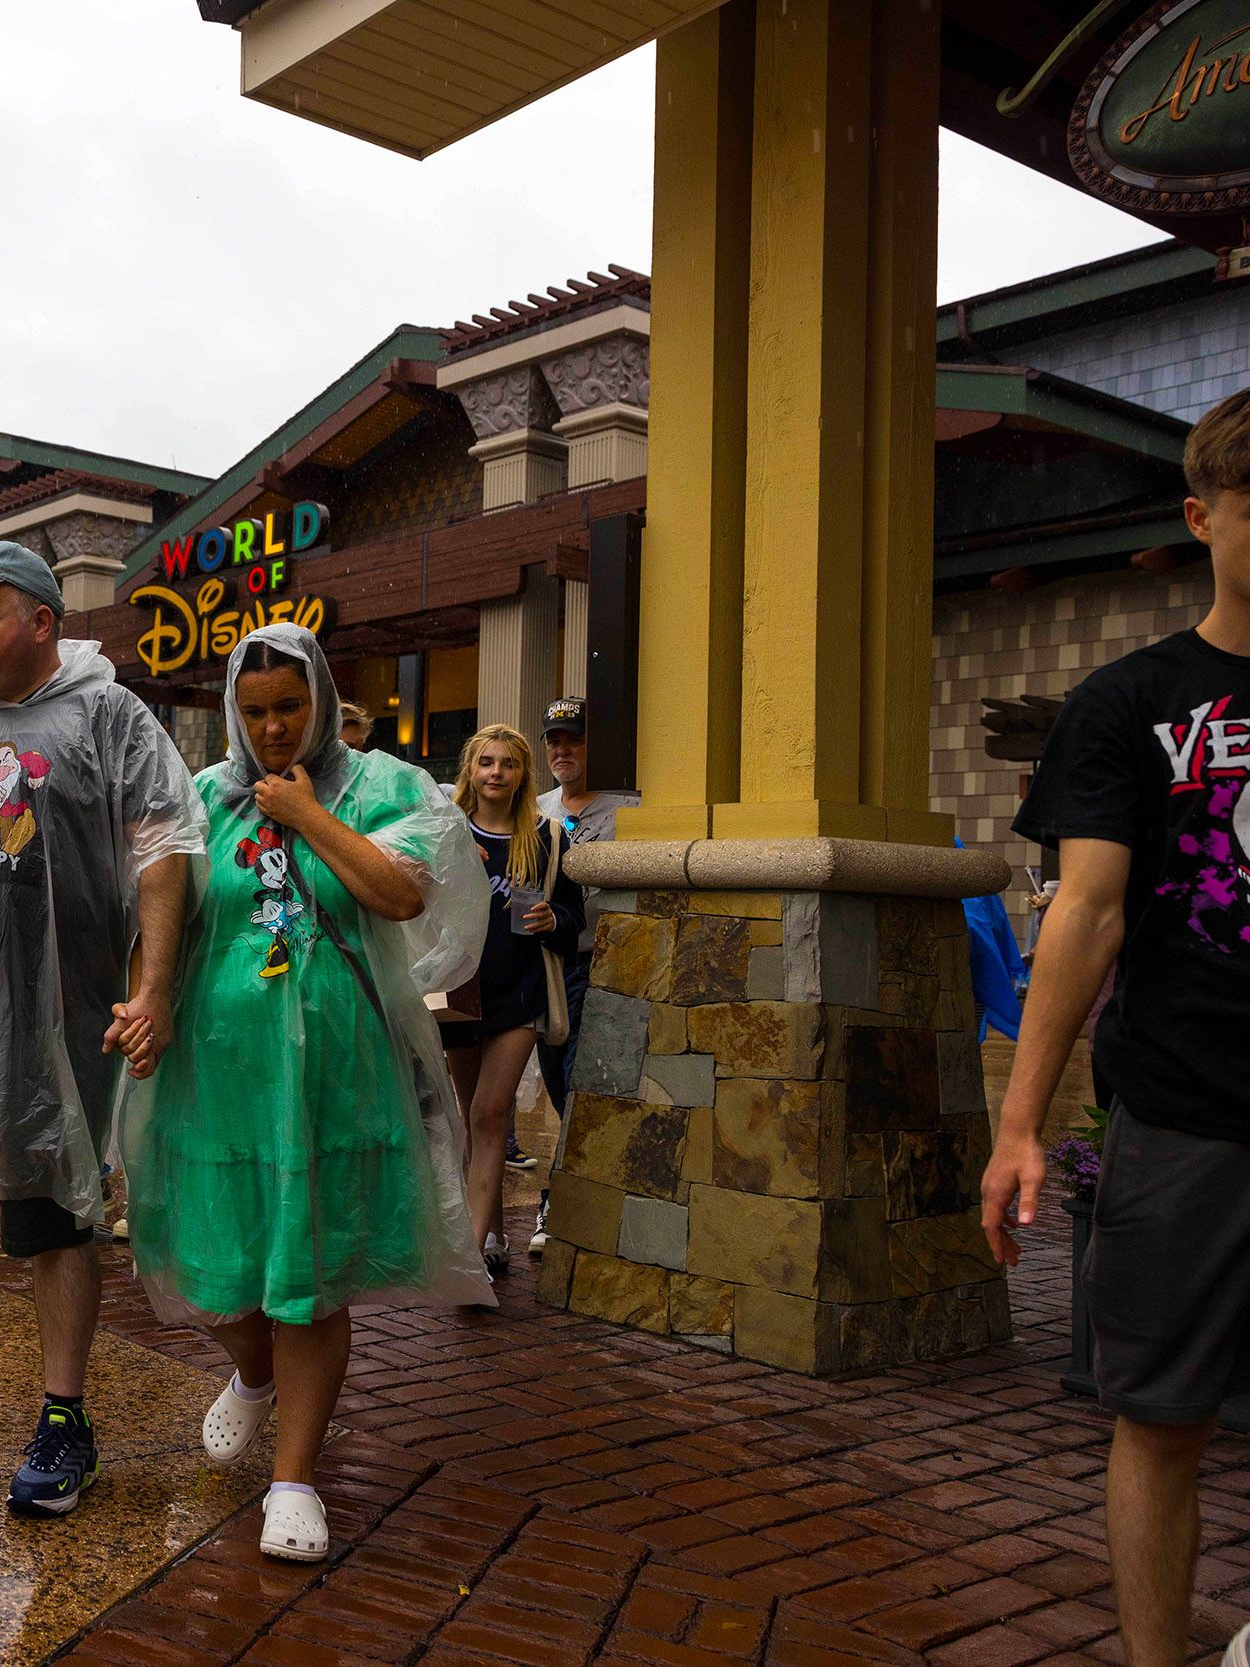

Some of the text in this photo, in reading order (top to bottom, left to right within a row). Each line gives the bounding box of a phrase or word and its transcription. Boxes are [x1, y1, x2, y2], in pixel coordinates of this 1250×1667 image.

[161, 501, 326, 579] WORLD
[248, 560, 286, 594] OF
[547, 703, 581, 717] CHAMPS
